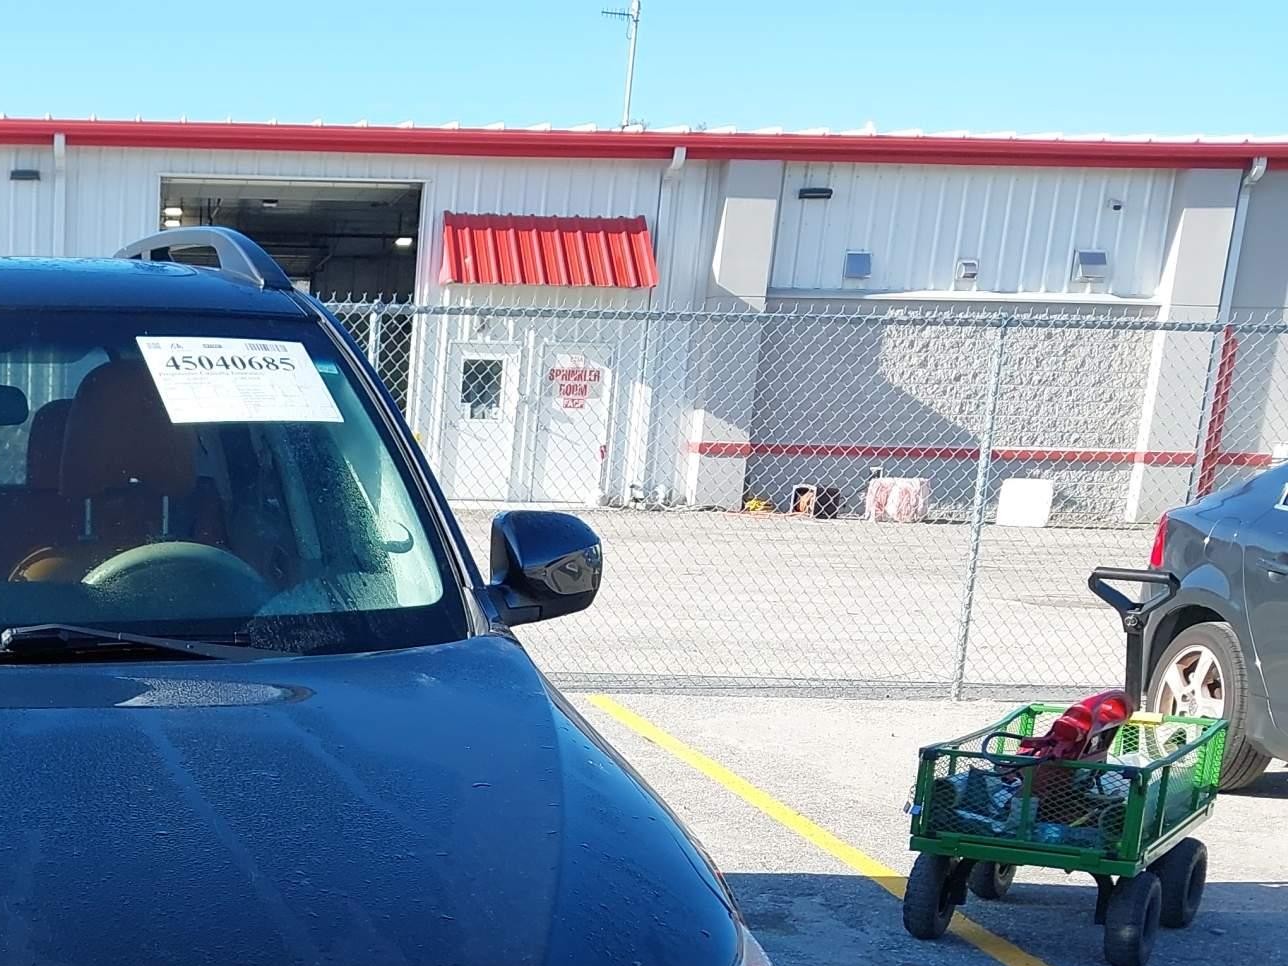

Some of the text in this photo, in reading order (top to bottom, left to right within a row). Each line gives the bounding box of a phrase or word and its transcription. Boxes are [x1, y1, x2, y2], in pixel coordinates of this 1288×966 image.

[165, 355, 296, 372] 45040685
[548, 368, 601, 382] SPRINKLER
[559, 383, 588, 397] ROOM
